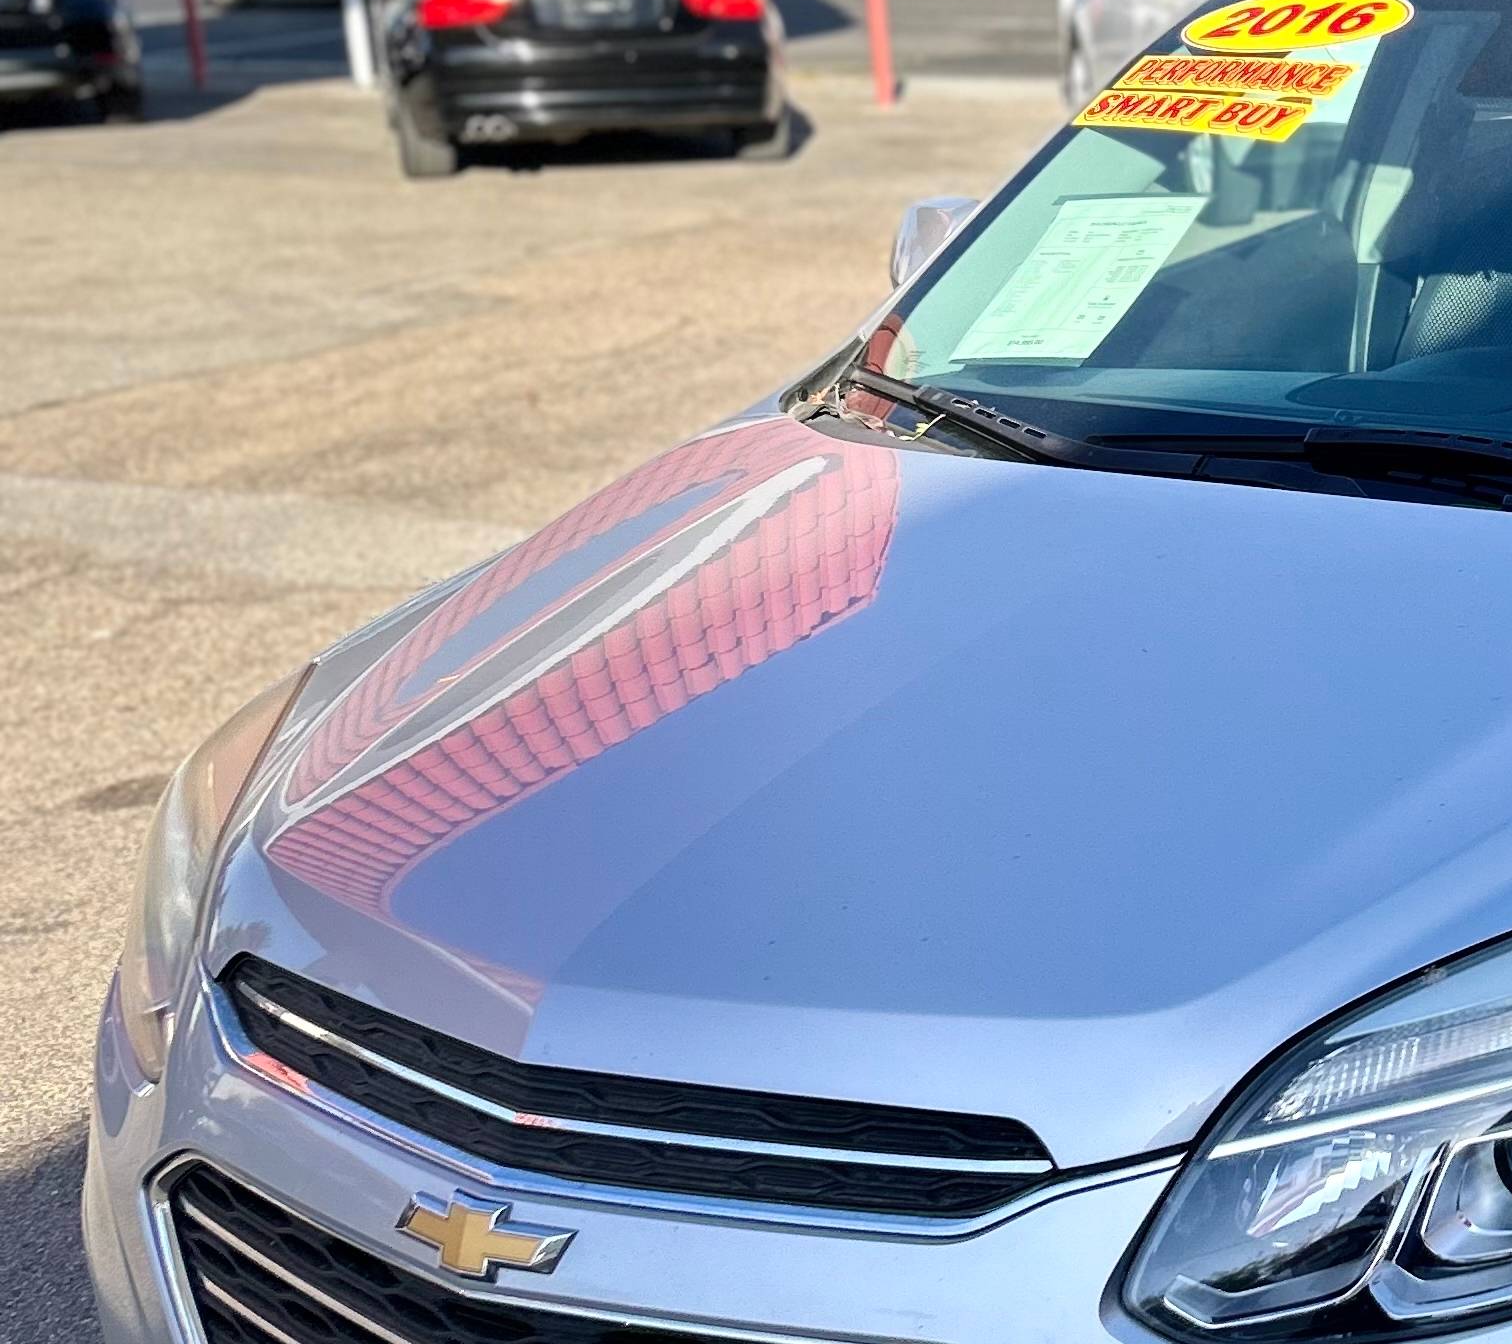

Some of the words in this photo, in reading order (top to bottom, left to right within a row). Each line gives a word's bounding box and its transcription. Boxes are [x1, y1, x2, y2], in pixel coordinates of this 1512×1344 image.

[1200, 2, 1389, 40] 2016
[1126, 58, 1353, 95] PERFORMANCE
[1086, 93, 1219, 128] SMART
[1209, 100, 1306, 133] BUY
